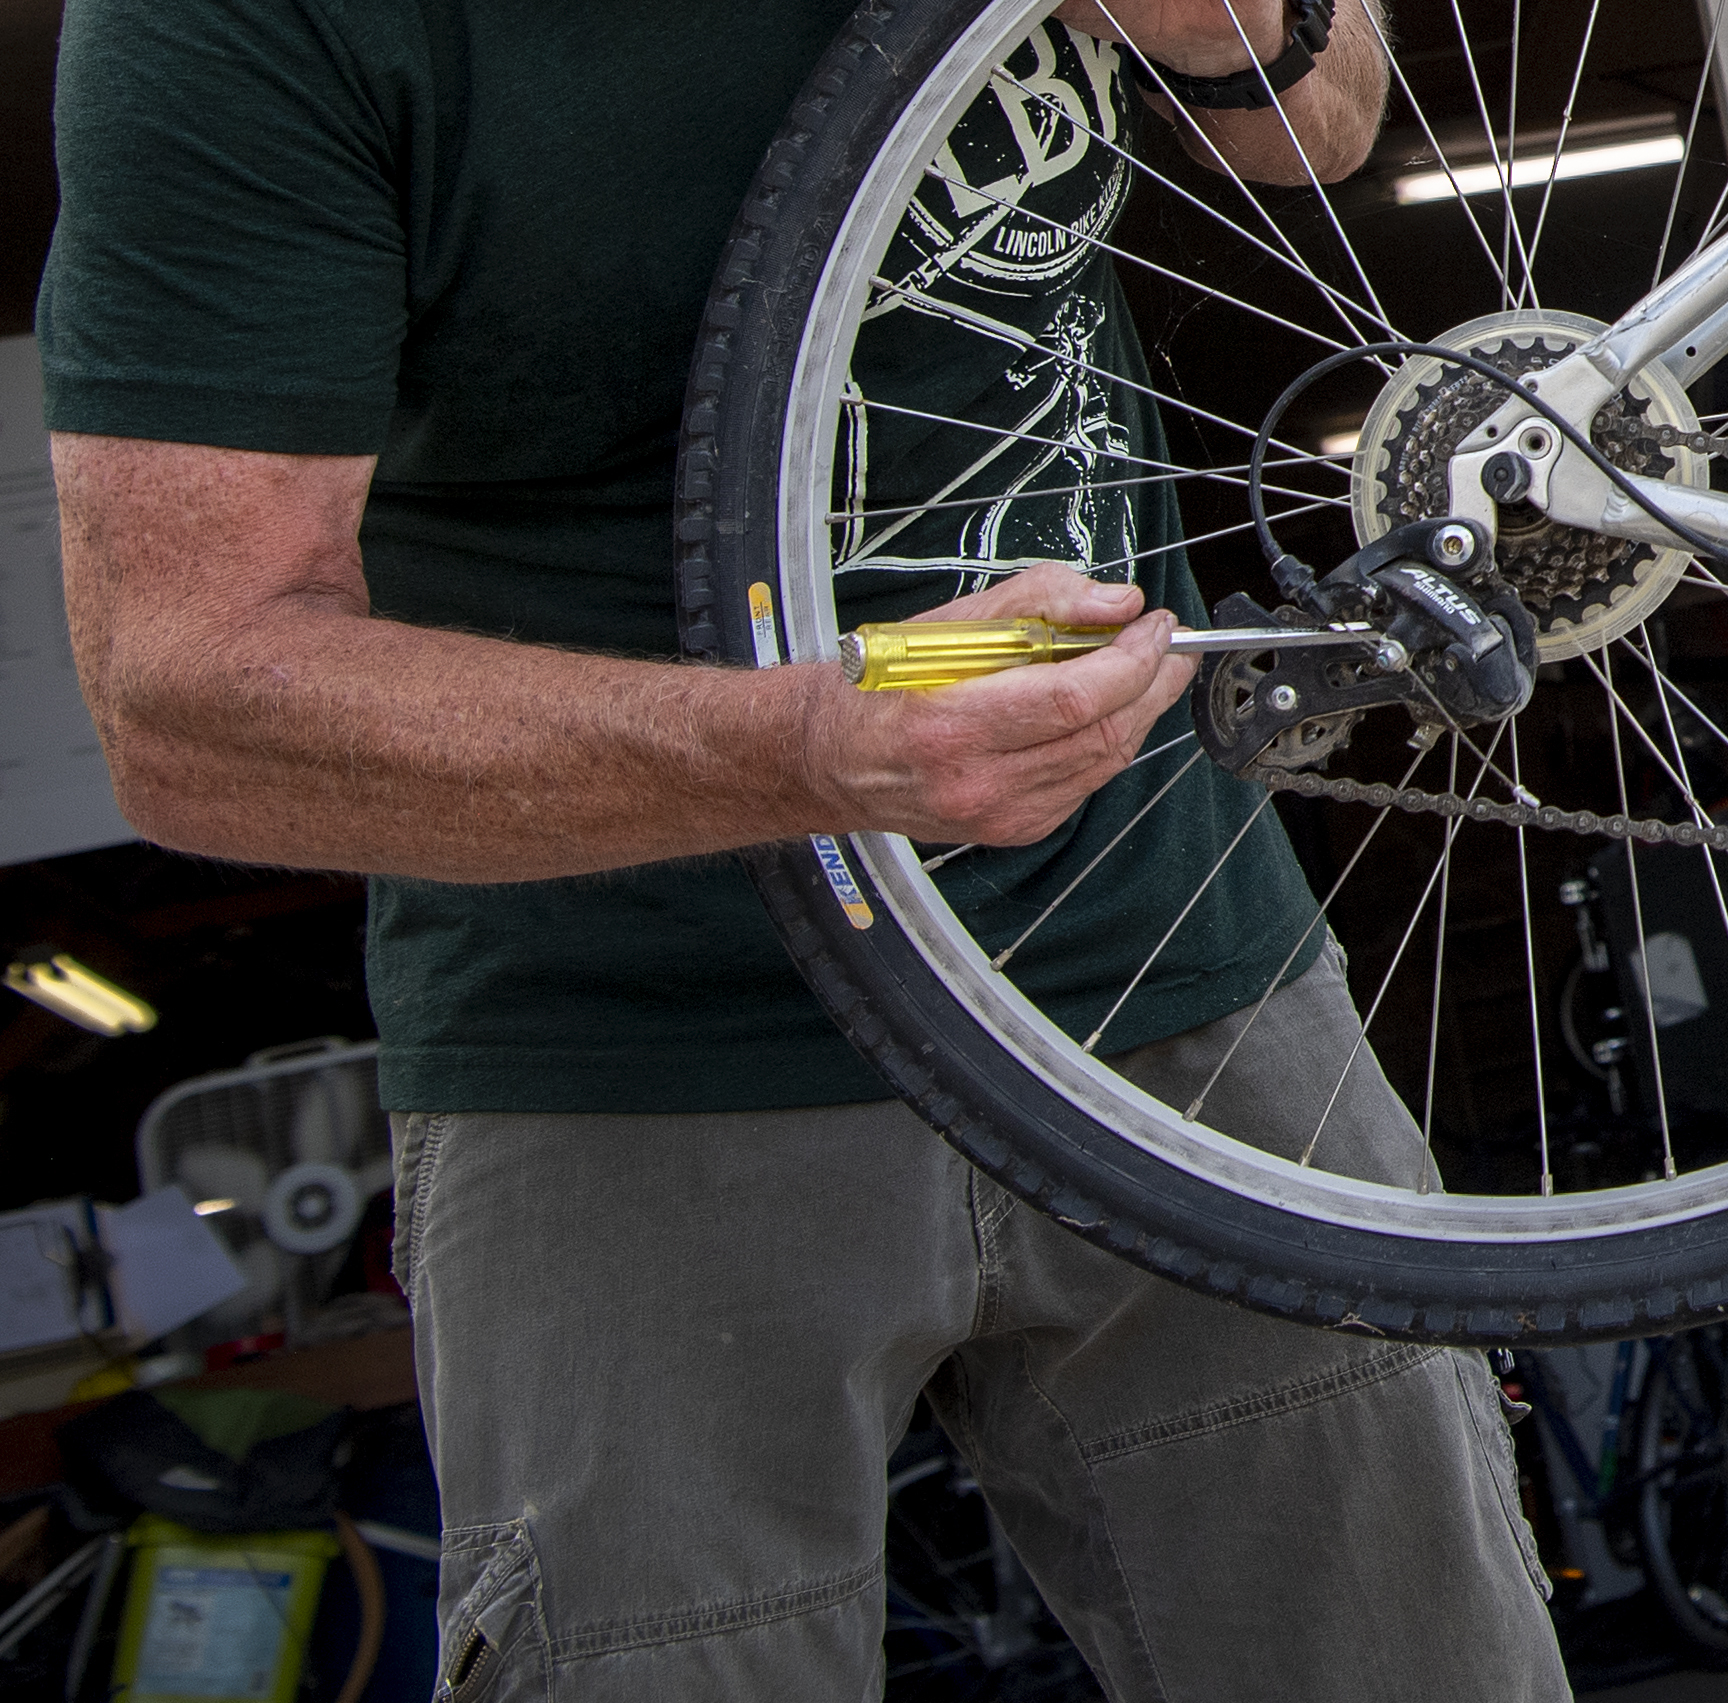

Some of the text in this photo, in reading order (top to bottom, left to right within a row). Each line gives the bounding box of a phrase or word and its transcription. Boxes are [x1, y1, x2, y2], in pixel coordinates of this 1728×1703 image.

[994, 226, 1067, 258] LINCOLN
[1070, 200, 1098, 245] BIKE
[1400, 568, 1482, 626] ALTUS
[1413, 580, 1456, 615] SHIMANO
[811, 834, 866, 906] KEND
